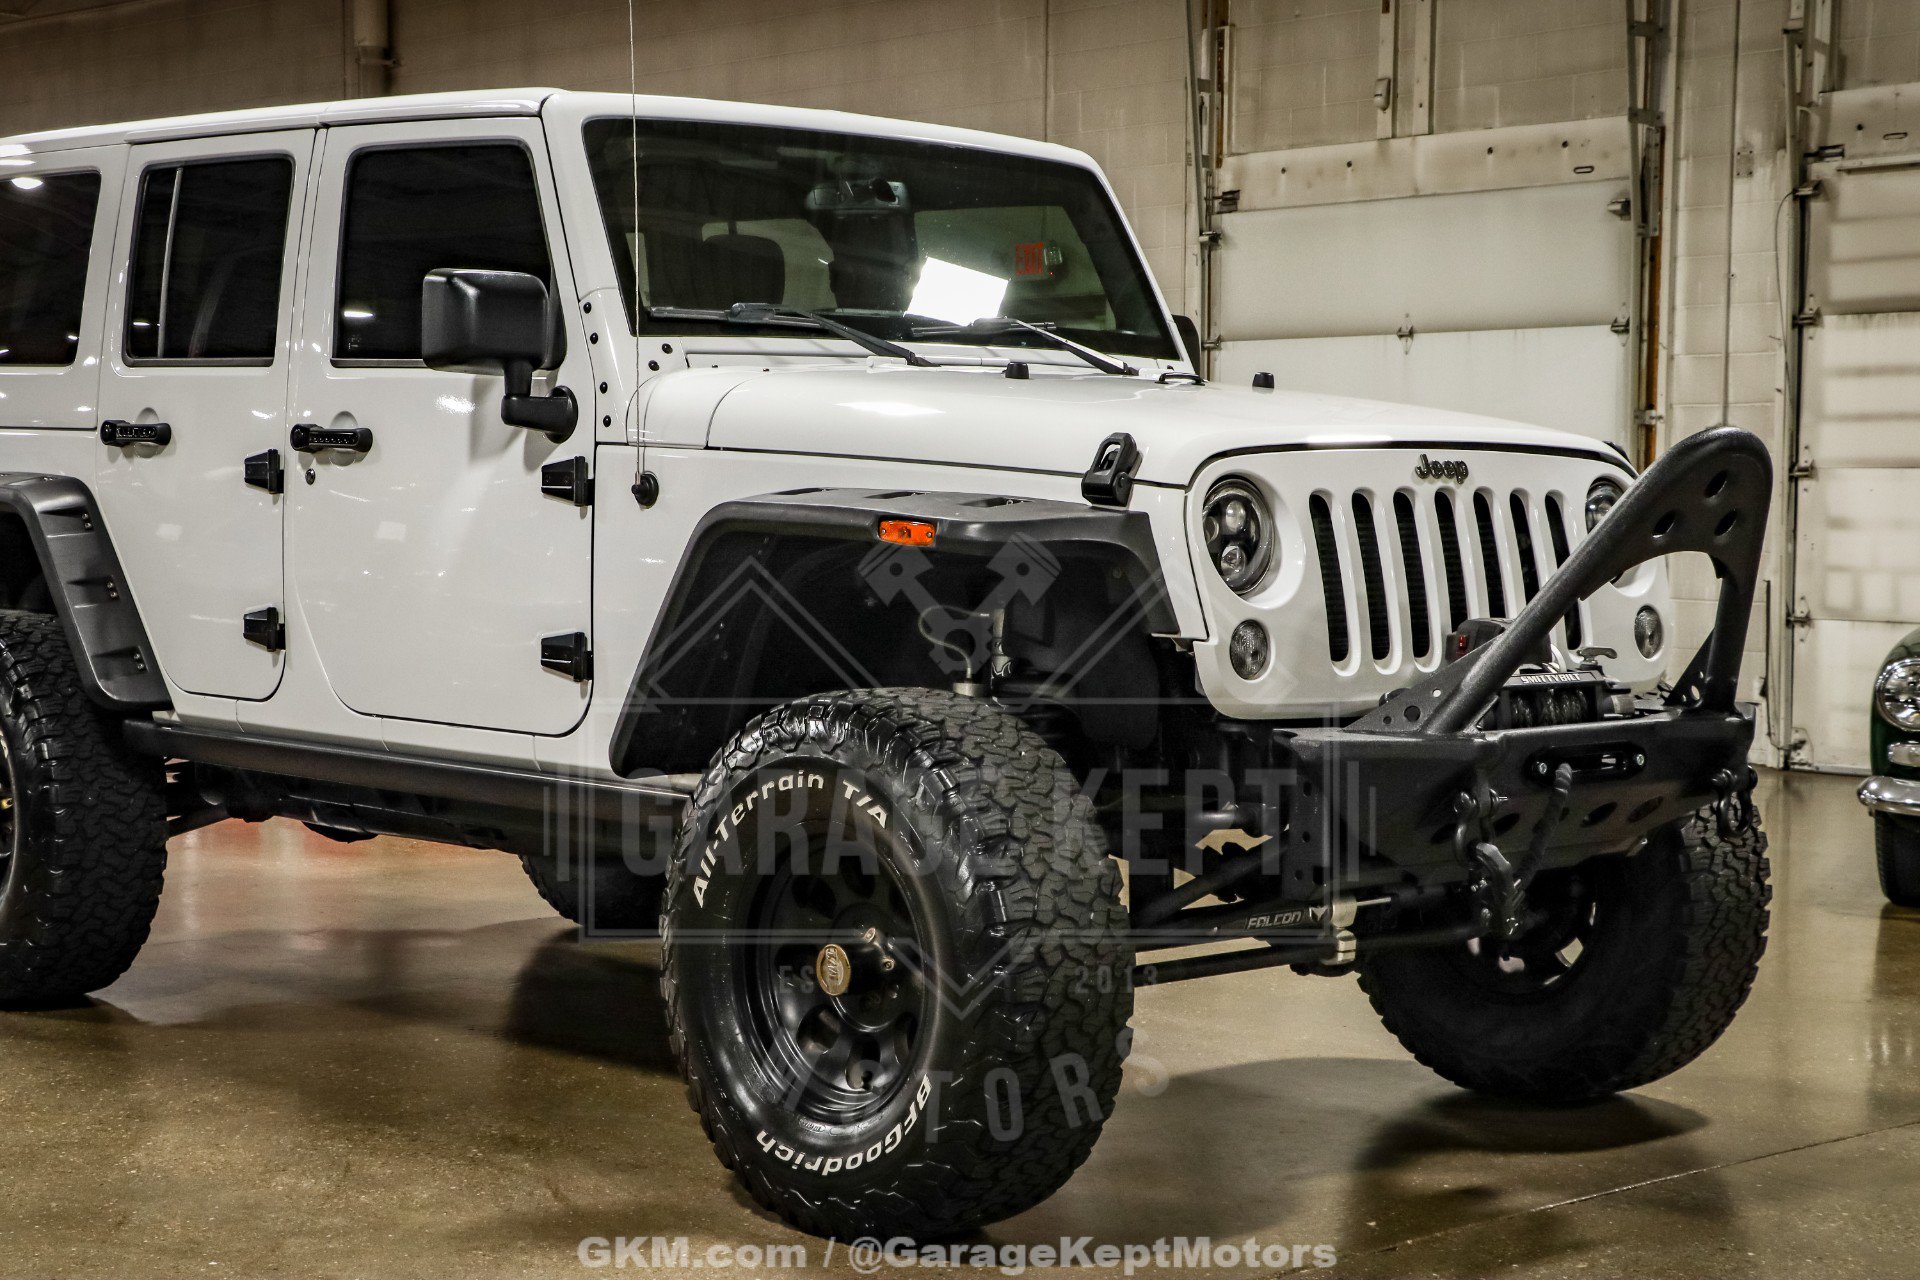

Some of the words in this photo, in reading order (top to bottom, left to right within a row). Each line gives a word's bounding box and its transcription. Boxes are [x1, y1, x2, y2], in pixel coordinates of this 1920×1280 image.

[1415, 453, 1469, 485] Jeep
[1520, 673, 1581, 685] SMITTYBILT
[693, 770, 825, 908] All-Terrain
[842, 779, 888, 829] T/A
[1247, 910, 1302, 930] FALCON
[756, 1073, 932, 1177] BFGoodrich
